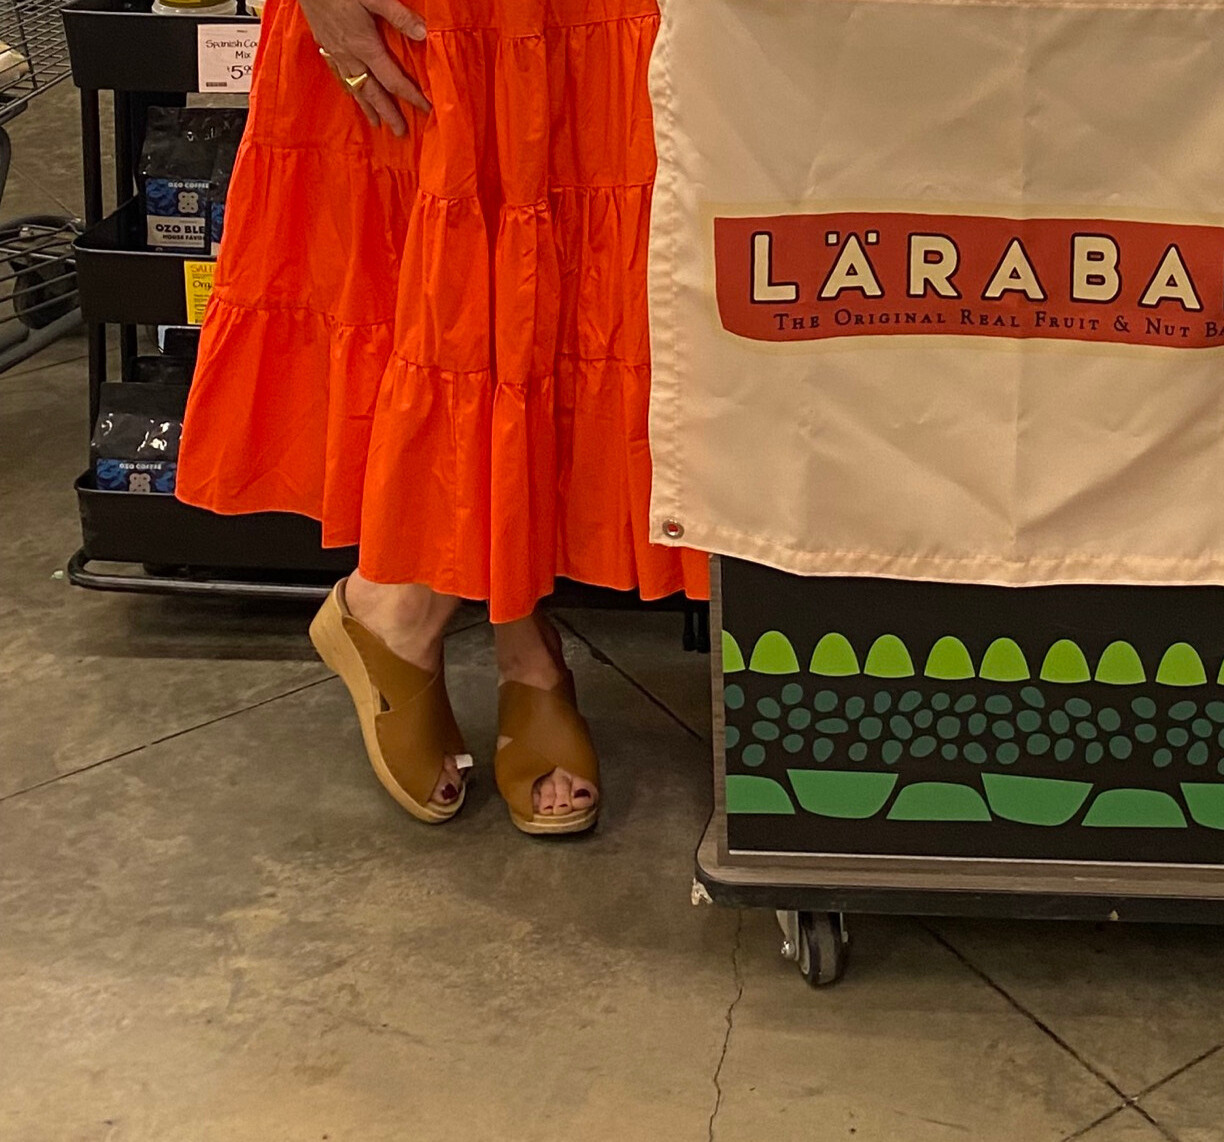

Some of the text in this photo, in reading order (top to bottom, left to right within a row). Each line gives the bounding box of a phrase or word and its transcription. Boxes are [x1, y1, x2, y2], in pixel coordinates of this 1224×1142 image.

[205, 39, 243, 49] Spanish
[235, 50, 251, 59] Mix
[155, 223, 182, 234] OZO
[1113, 314, 1130, 333] &
